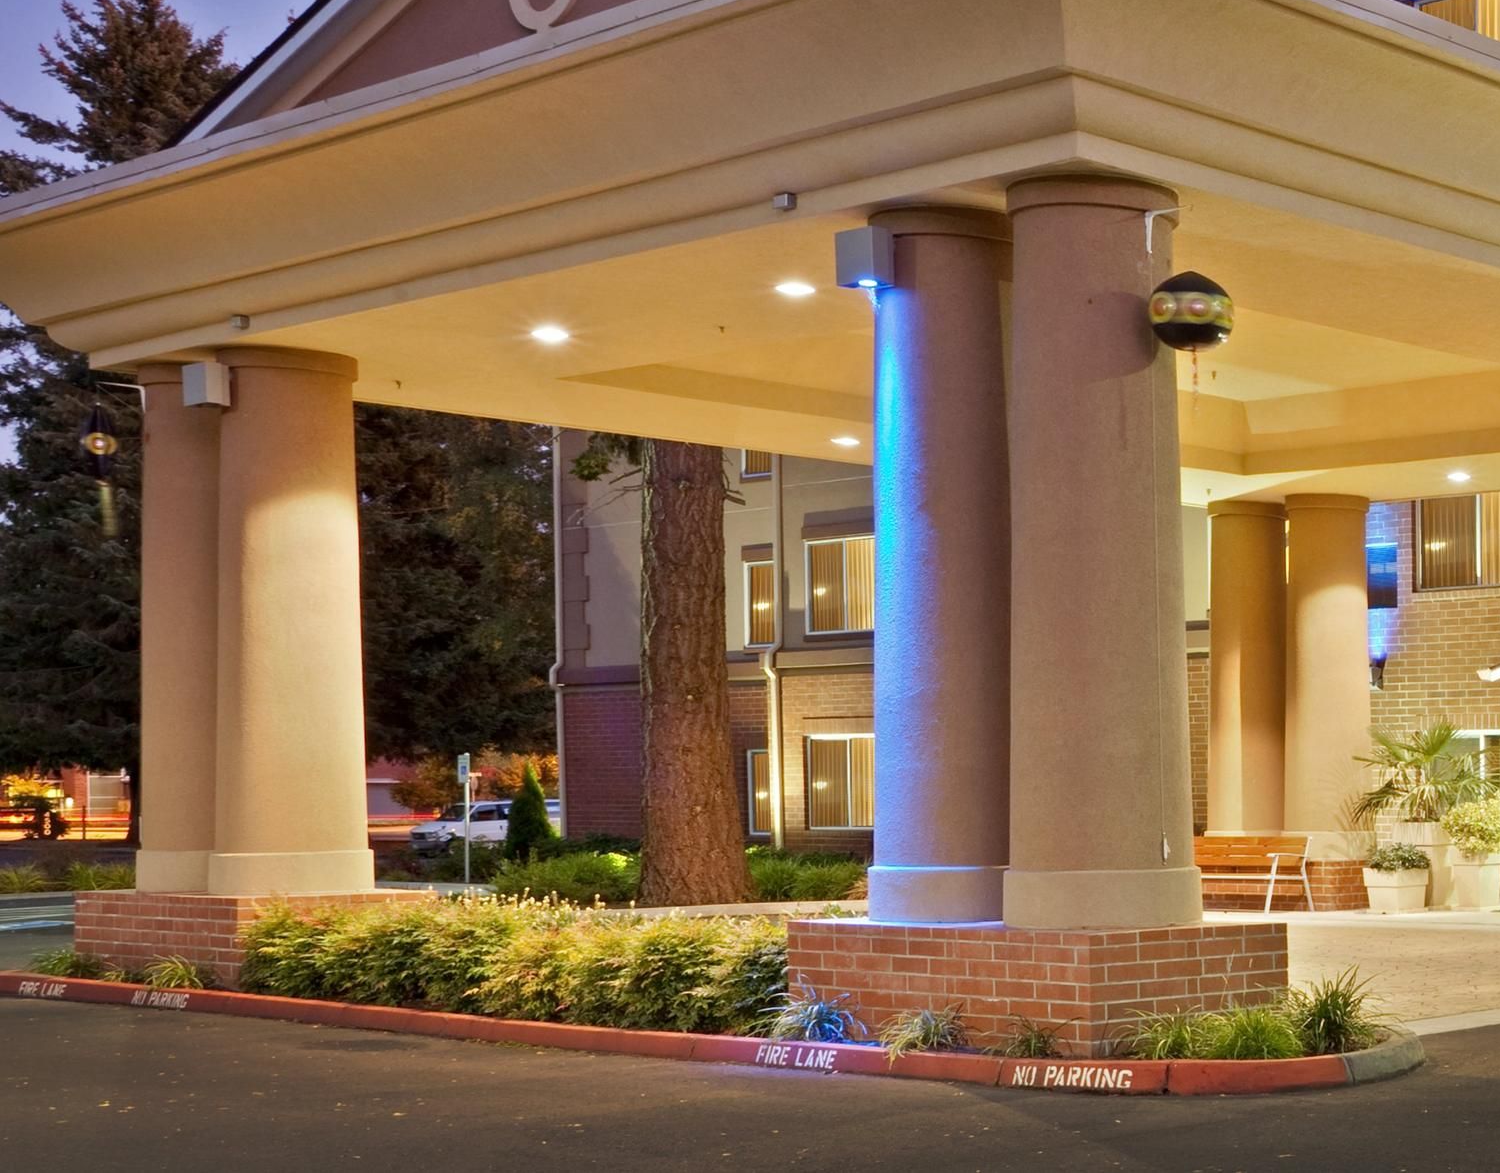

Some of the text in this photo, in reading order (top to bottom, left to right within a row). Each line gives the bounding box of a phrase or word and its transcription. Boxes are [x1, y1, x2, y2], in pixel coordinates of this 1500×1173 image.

[18, 981, 67, 998] FIRE LANE
[130, 990, 189, 1008] NO PARKING
[755, 1045, 837, 1069] FIRE LANE
[1012, 1065, 1133, 1089] NO PARKING
